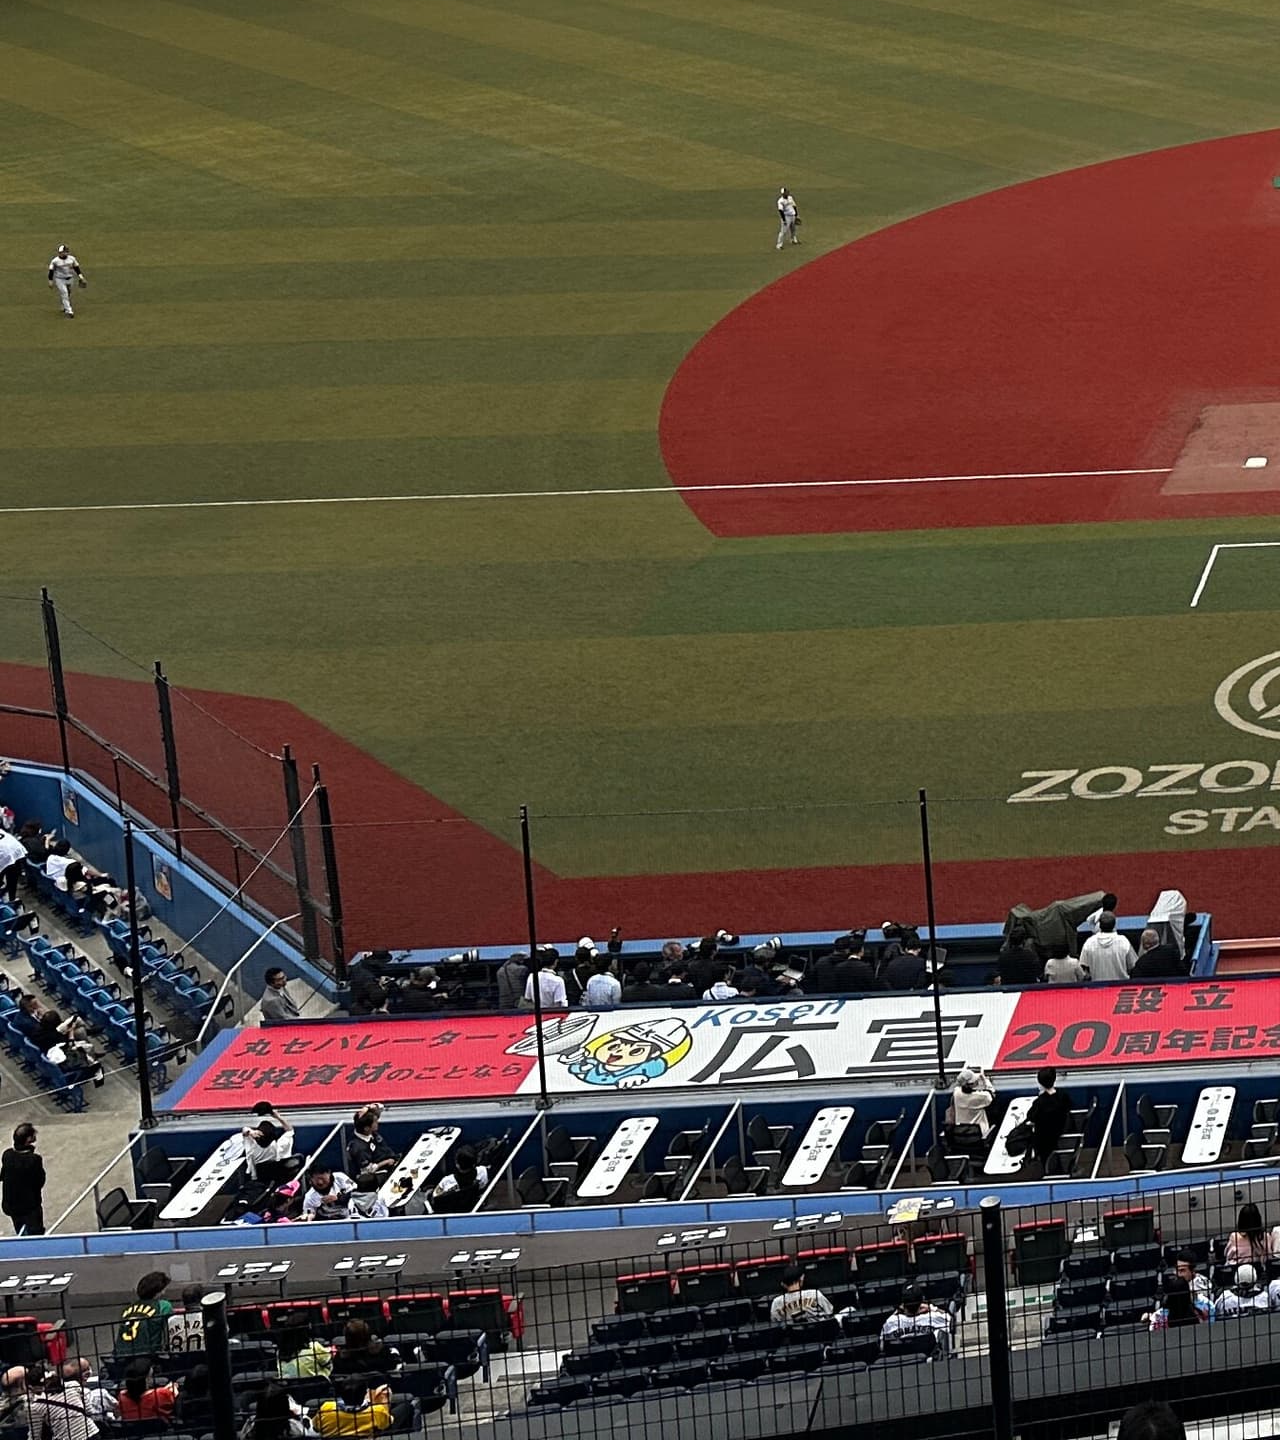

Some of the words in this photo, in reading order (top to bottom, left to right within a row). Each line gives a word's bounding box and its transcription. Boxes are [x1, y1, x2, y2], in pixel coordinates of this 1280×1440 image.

[1112, 984, 1236, 1015] 設立
[687, 1011, 984, 1086] 広宣
[204, 1060, 525, 1091] 型枠資材のことなら
[122, 1320, 140, 1341] 3
